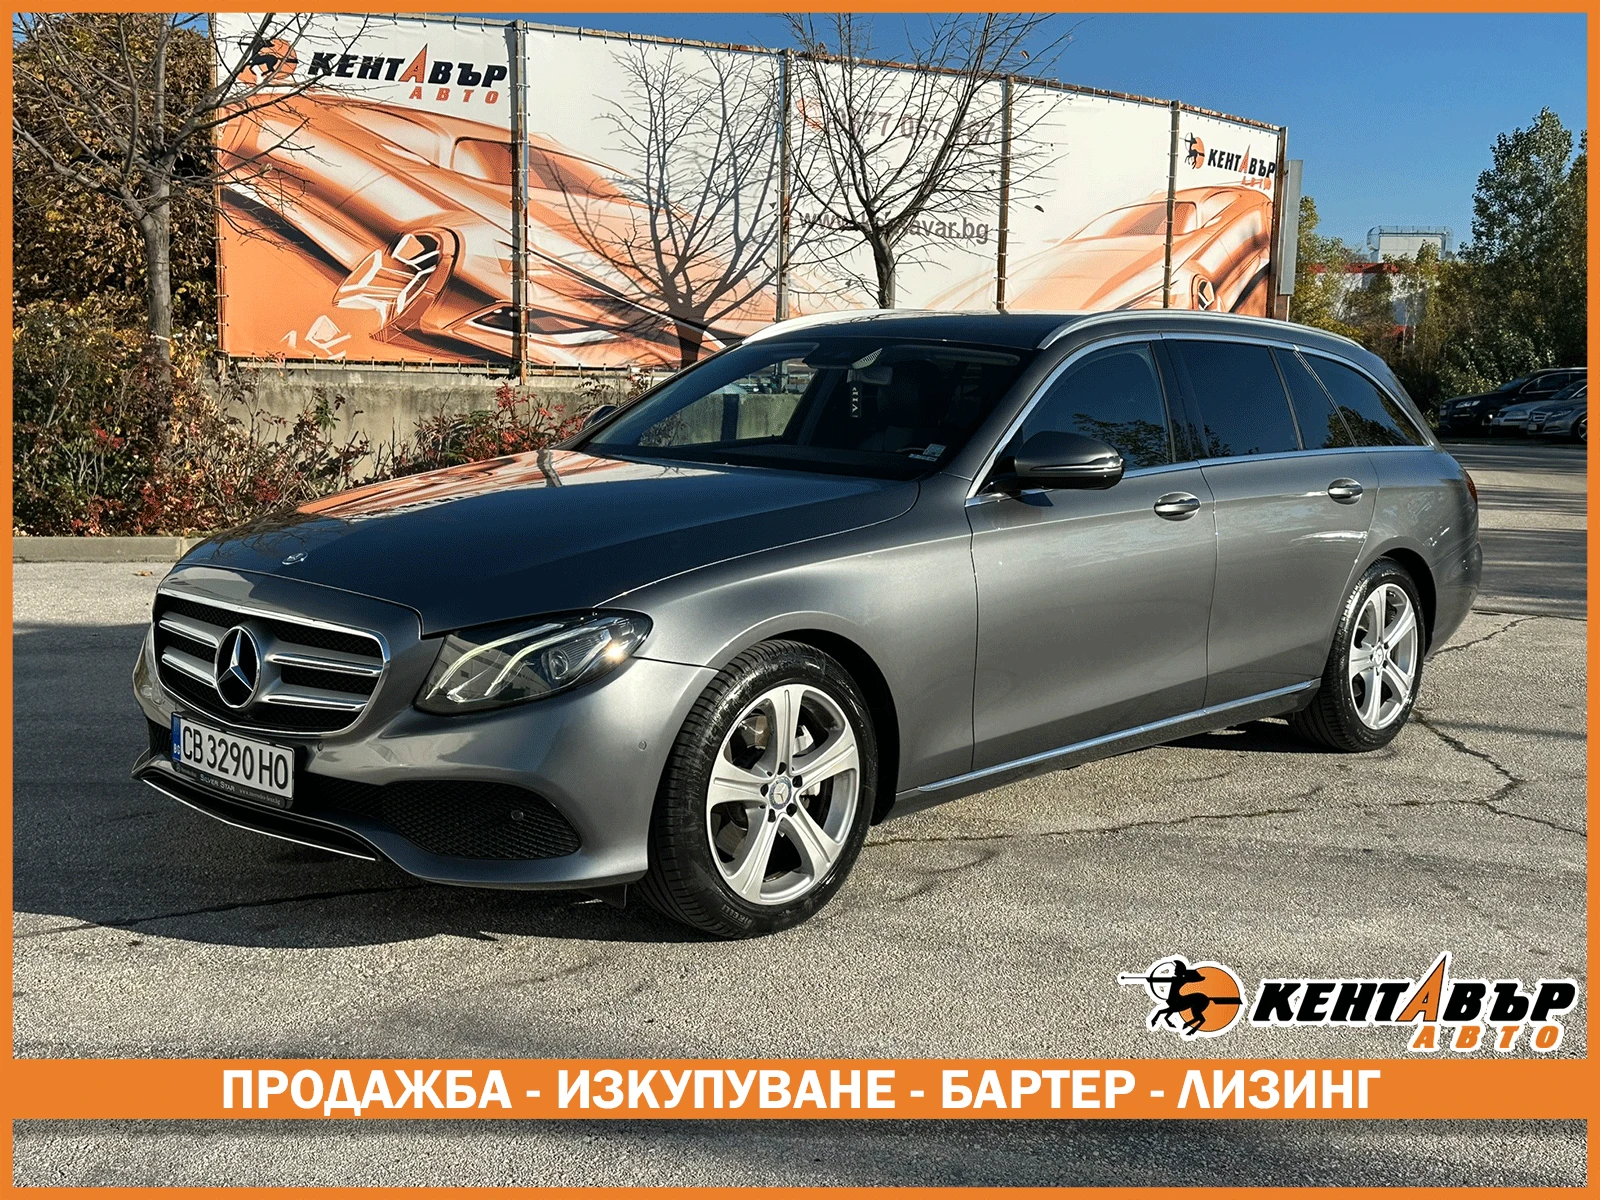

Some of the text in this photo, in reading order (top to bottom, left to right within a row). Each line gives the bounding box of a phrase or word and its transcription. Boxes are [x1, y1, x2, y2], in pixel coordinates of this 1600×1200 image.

[307, 43, 507, 87] КЕНТАВЪР
[409, 86, 499, 104] АВТО
[1207, 144, 1276, 178] КЕНТАВЪР
[206, 734, 254, 781] 3290
